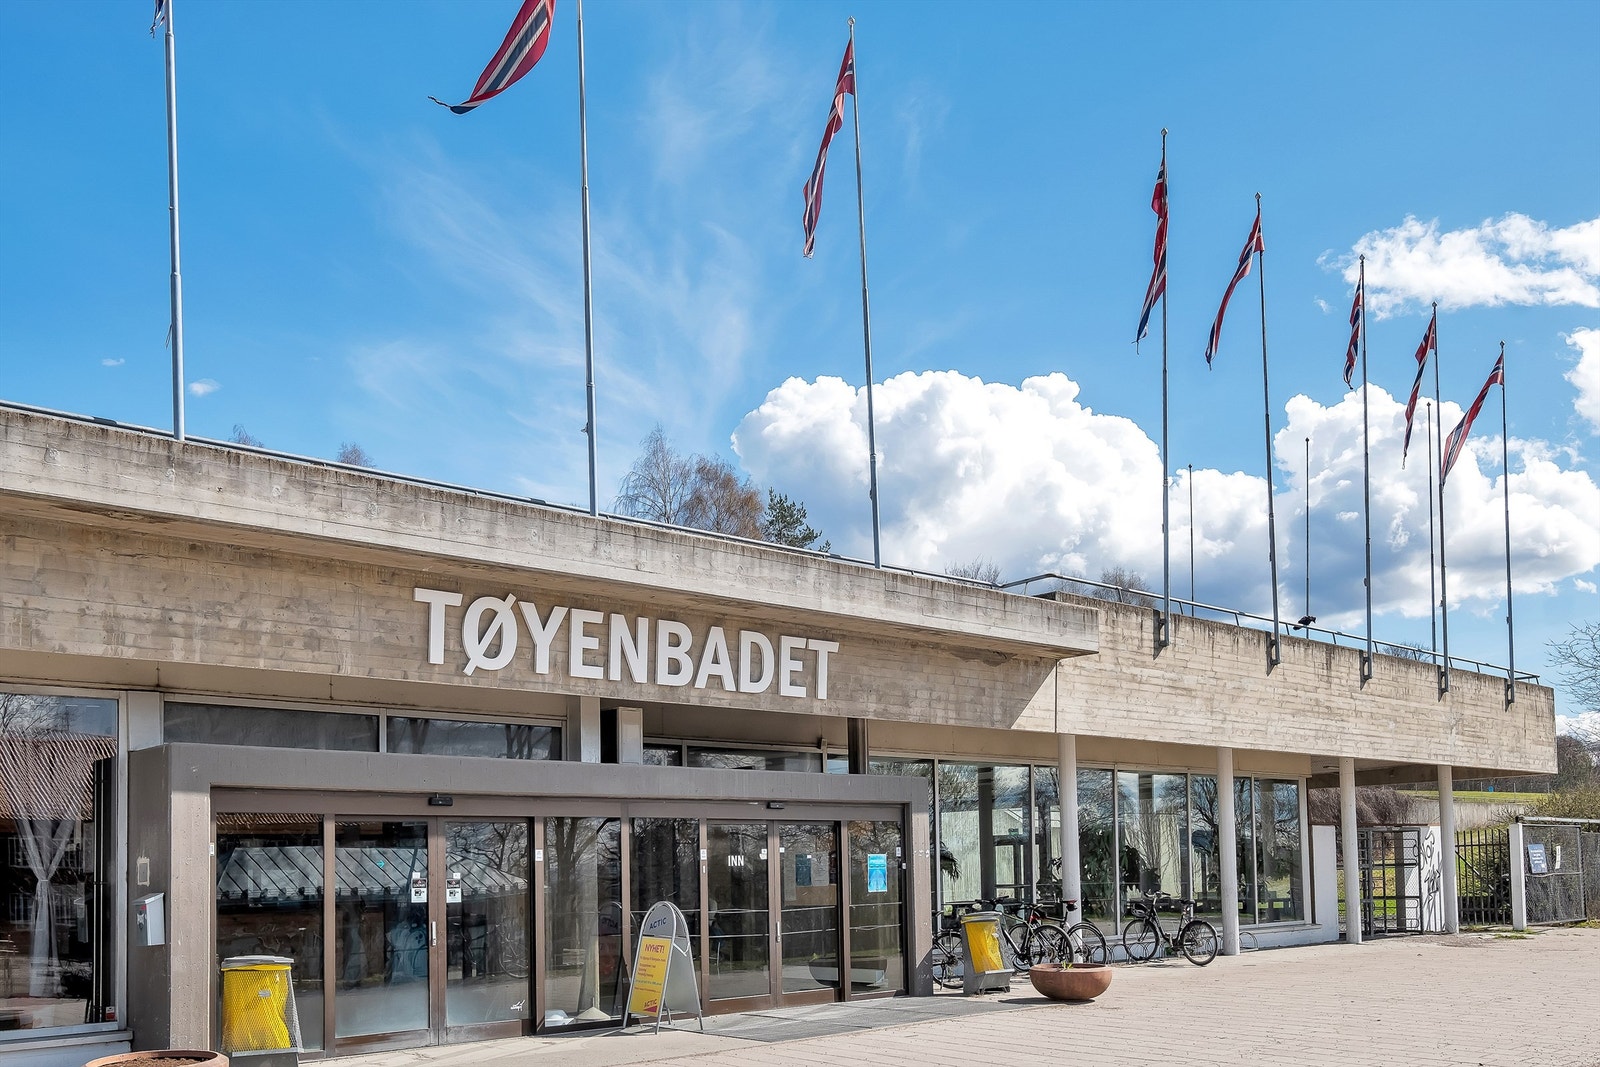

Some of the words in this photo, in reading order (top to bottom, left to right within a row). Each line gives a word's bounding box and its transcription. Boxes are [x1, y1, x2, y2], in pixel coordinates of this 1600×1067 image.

[413, 587, 839, 700] TØYENBADET
[728, 855, 744, 866] INN
[649, 917, 667, 929] ACTIC
[644, 943, 665, 954] NYHET!
